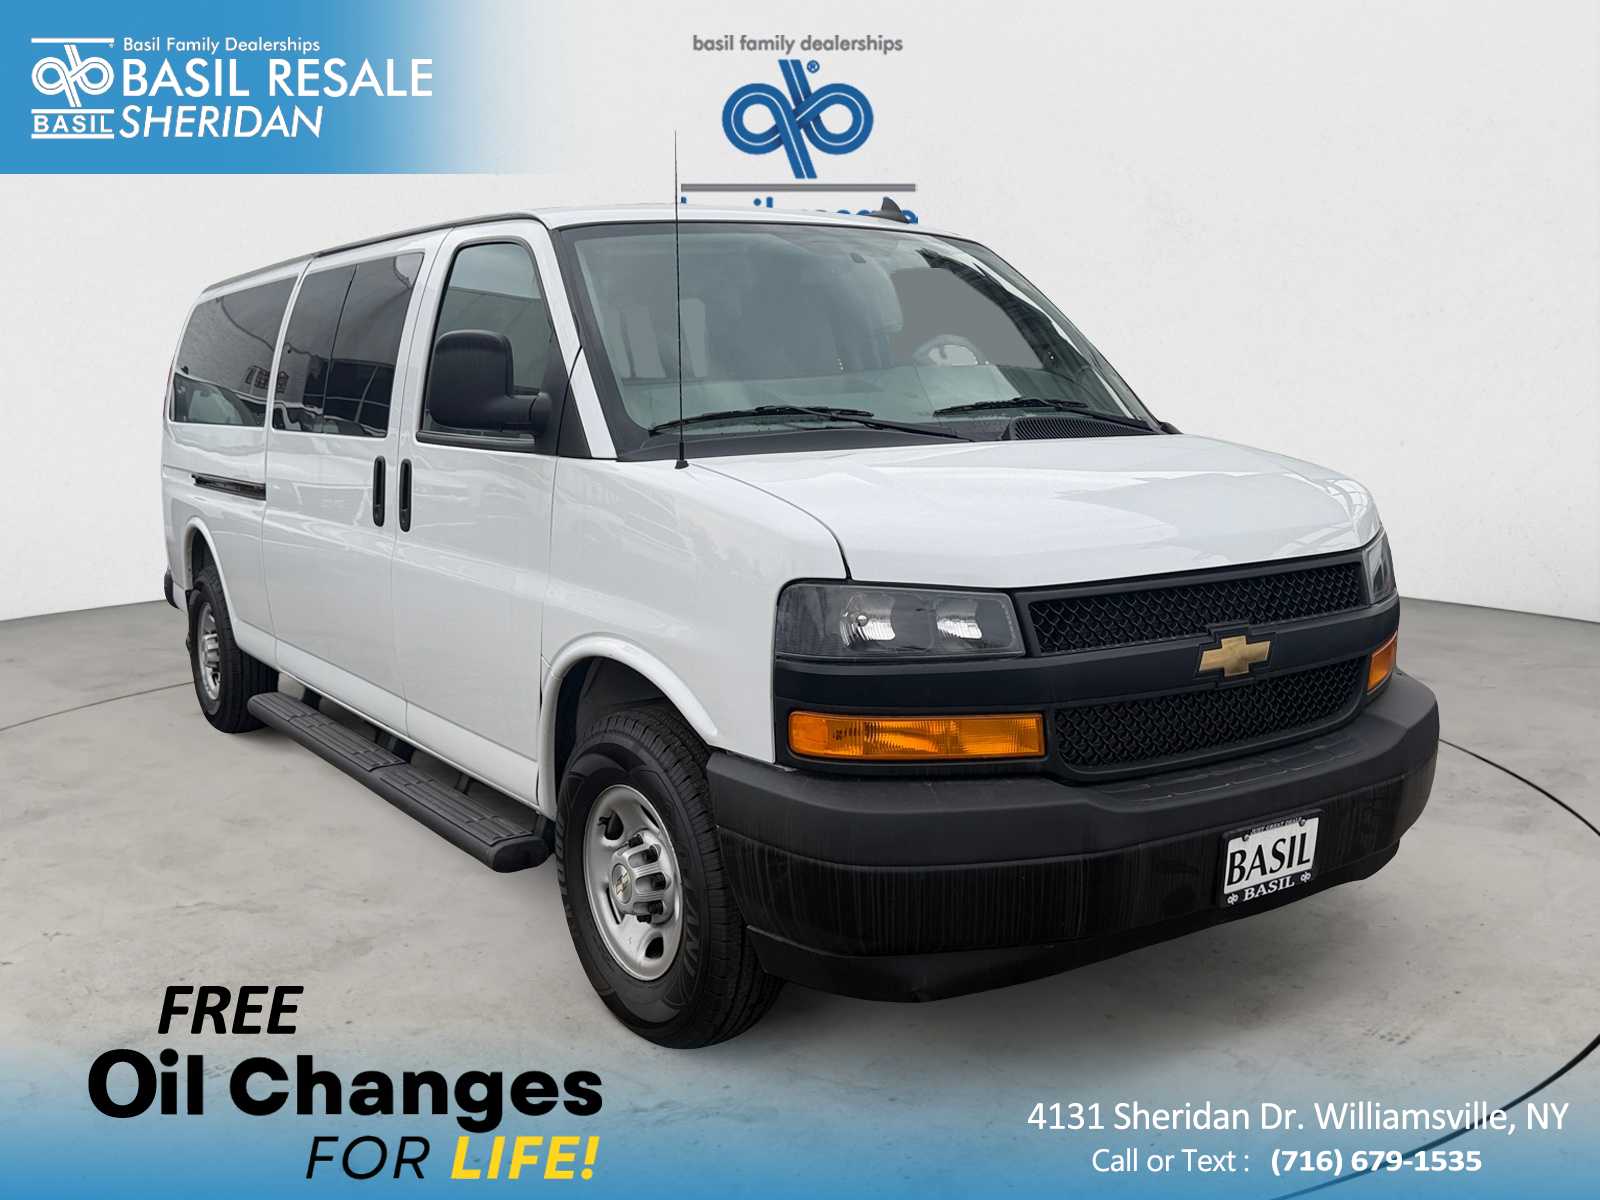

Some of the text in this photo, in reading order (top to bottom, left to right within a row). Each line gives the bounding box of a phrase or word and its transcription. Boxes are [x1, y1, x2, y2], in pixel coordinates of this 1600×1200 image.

[692, 35, 903, 55] basil family dealerships
[1226, 832, 1311, 886] BASIL
[1243, 876, 1295, 901] BASIL
